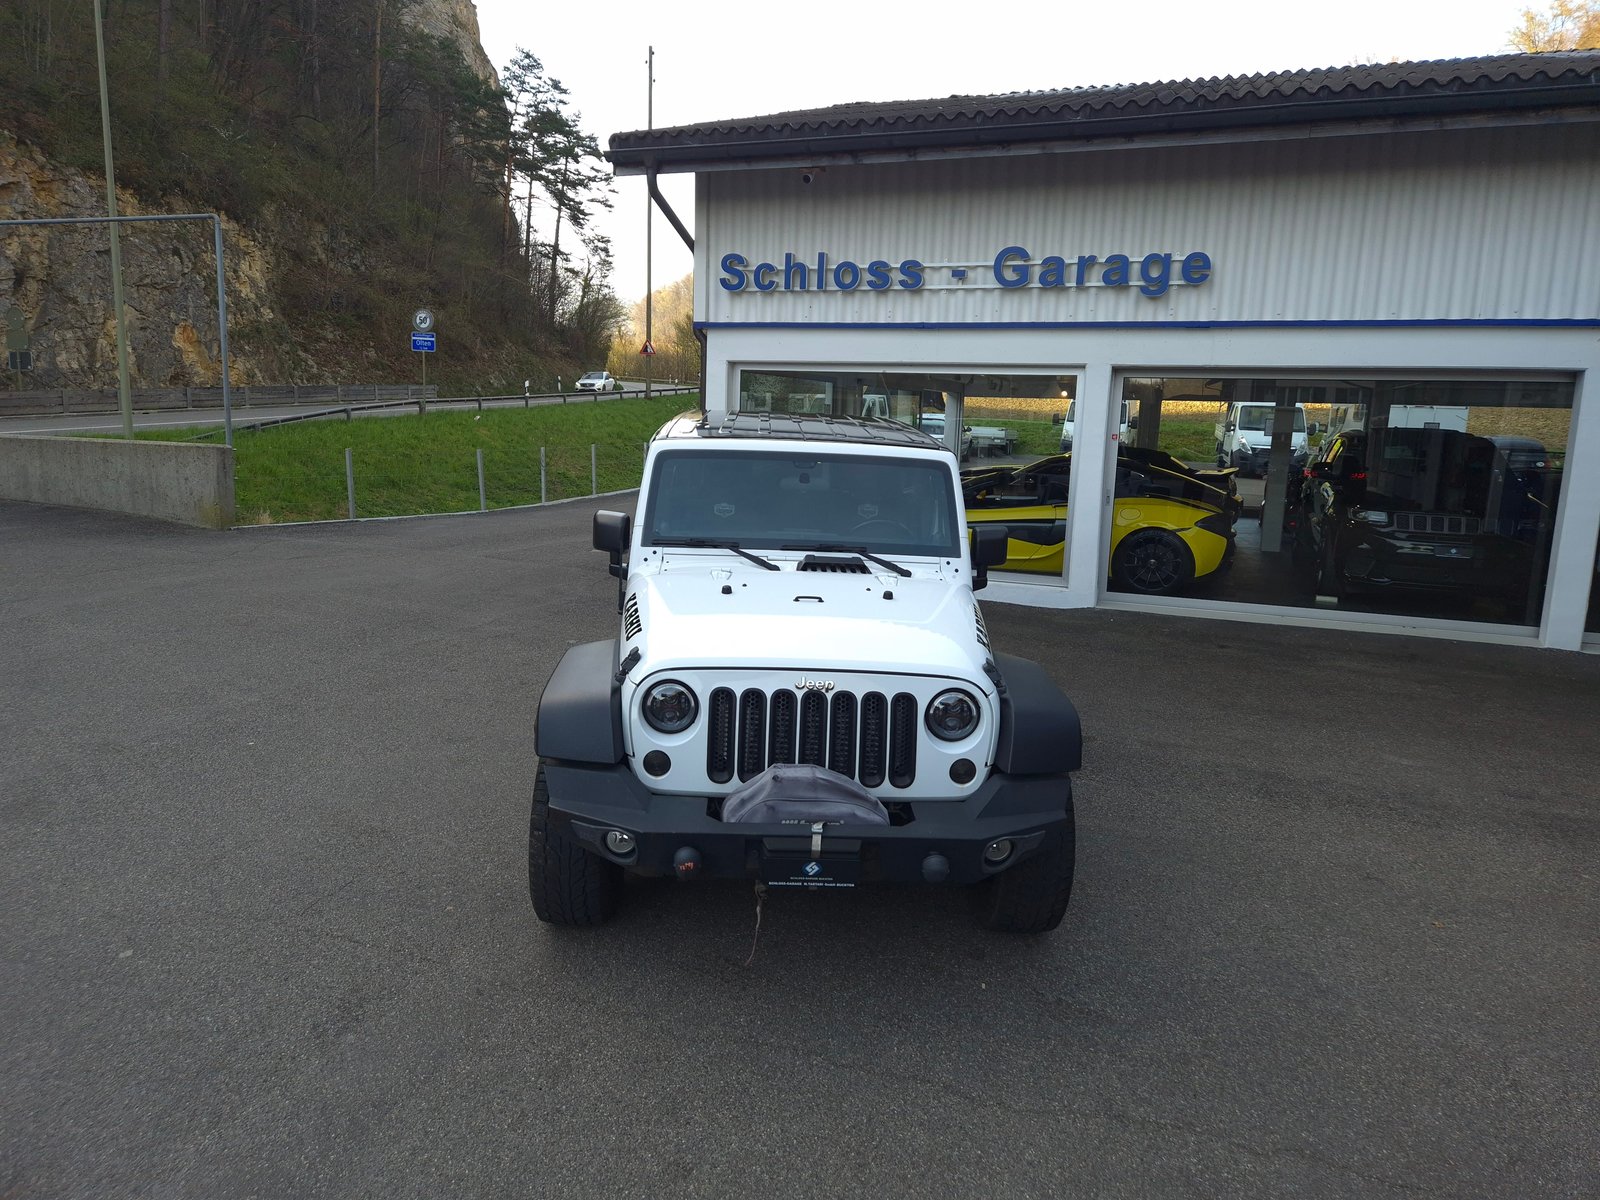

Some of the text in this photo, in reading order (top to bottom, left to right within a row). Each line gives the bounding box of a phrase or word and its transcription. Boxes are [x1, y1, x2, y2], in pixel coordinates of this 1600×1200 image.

[719, 251, 925, 292] Schloss
[993, 245, 1212, 298] Garage
[418, 316, 428, 325] 50
[795, 676, 835, 693] Jeep
